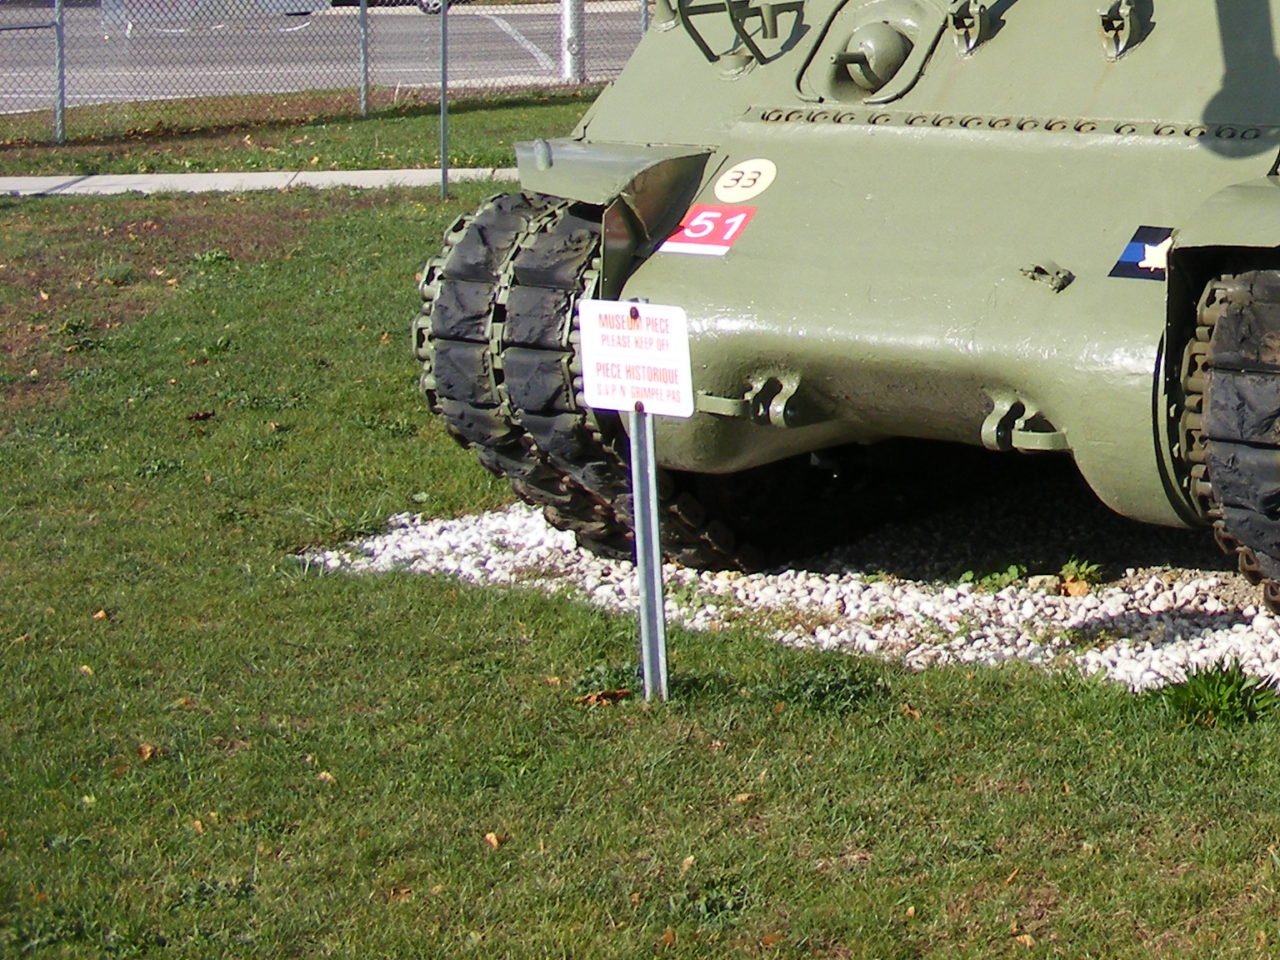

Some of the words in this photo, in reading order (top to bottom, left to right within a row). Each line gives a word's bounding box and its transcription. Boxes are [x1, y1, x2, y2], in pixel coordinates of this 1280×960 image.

[722, 171, 761, 188] 33
[684, 211, 747, 240] 51
[598, 313, 642, 331] MUSEUM
[645, 316, 670, 334] PIECE
[601, 334, 631, 348] PLEASE
[634, 336, 654, 350] KEEP
[656, 338, 670, 352] OFF
[596, 362, 621, 379] PIECE
[625, 364, 679, 385] HISTORIQUE
